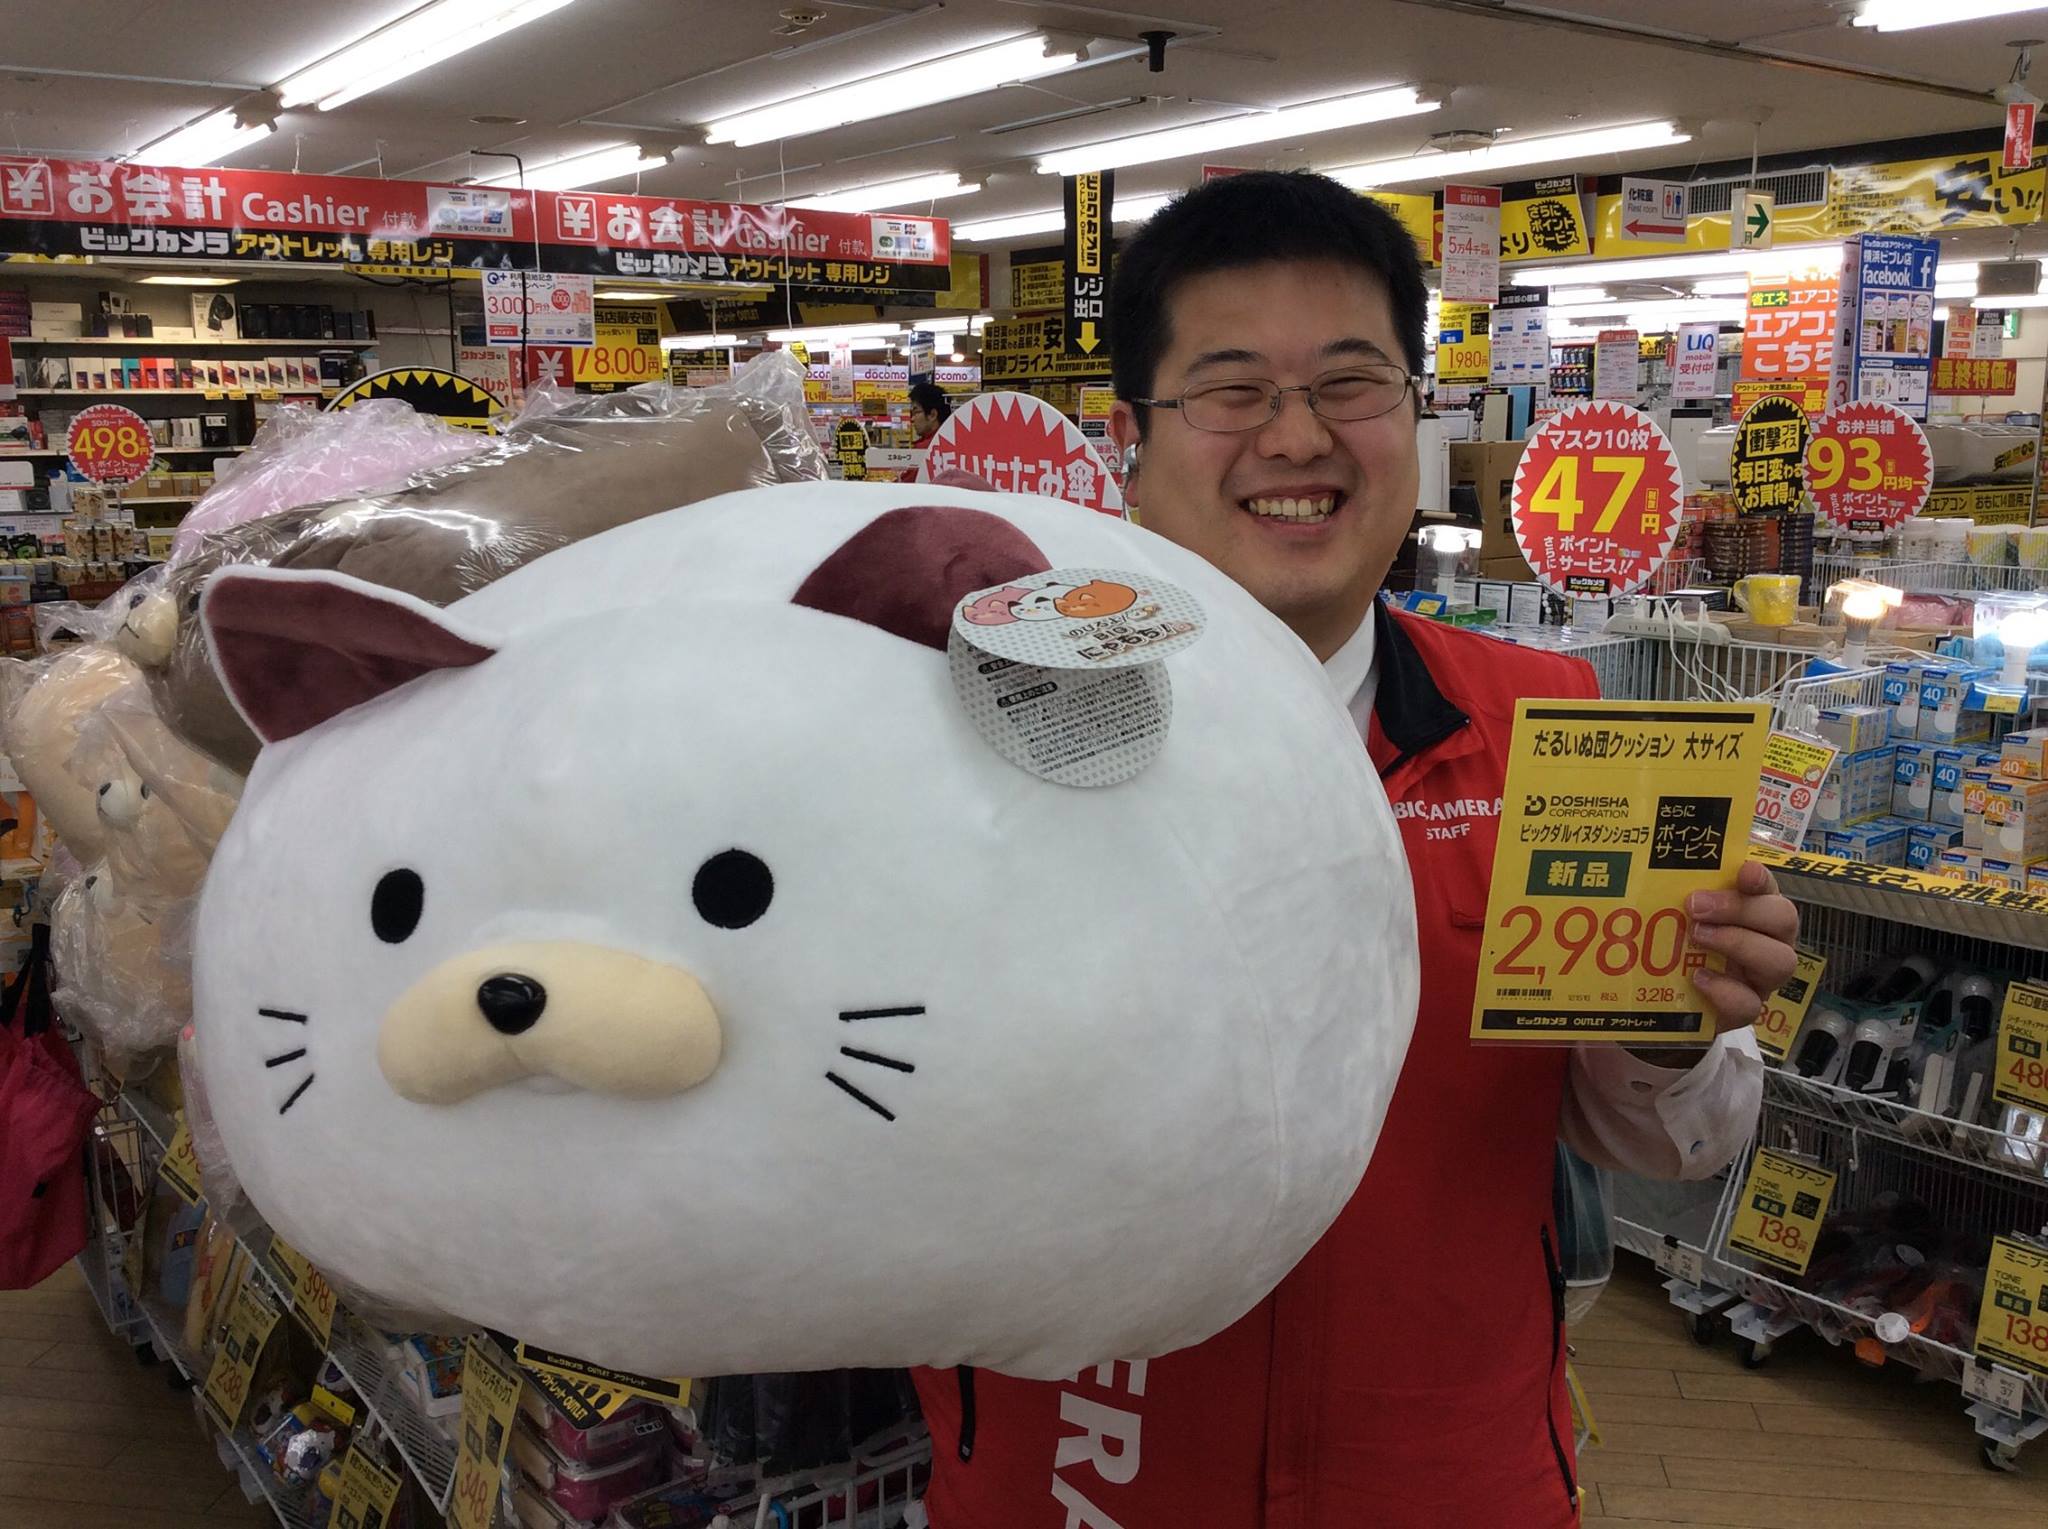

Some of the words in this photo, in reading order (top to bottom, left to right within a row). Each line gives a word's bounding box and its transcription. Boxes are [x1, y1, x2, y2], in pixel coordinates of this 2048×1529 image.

[67, 170, 227, 221] お会計
[242, 192, 370, 226] Cashier
[1528, 205, 1561, 219] さらに
[606, 203, 725, 247] お会計
[734, 223, 830, 254] Cashier
[1531, 218, 1577, 232] ポイント
[80, 226, 230, 255] ビックカメラ
[235, 233, 359, 258] アウトレット
[367, 238, 454, 263] 専用レジ
[1532, 232, 1579, 246] サービス
[1863, 249, 1913, 266] 横浜ビブレ店
[615, 251, 729, 277] ビックカメラ
[730, 257, 821, 282] アウトレット
[826, 262, 891, 284] 専用レジ
[1862, 263, 1911, 287] facebook
[1751, 291, 1789, 307] 省エネ
[1074, 298, 1104, 319] 出口
[1686, 332, 1715, 353] UQ
[984, 354, 1054, 376] 衝撃プライス
[1685, 353, 1712, 361] mobile
[864, 368, 907, 380] docomo
[1936, 359, 2017, 390] 最終特価!!
[1837, 419, 1896, 435] お弁当箱
[74, 426, 140, 460] 498
[1547, 428, 1651, 451] マスク10枚
[1749, 427, 1781, 453] 衝撃
[97, 460, 129, 468] ポイント
[1738, 458, 1802, 485] 毎日変わる
[1807, 436, 1884, 491] 93
[1883, 476, 1929, 491] 円均一
[1529, 455, 1646, 534] 47
[1744, 483, 1797, 509] お買得!!
[1842, 493, 1888, 505] ポイント
[1842, 505, 1901, 519] サービス!!
[1640, 512, 1661, 535] 円
[1543, 535, 1558, 570] さらに
[1559, 535, 1618, 555] ポイント
[1559, 555, 1635, 575] サービス!!
[1093, 625, 1130, 641] BIG
[1885, 682, 1904, 697] 40
[1923, 687, 1941, 701] 40
[1532, 729, 1676, 759] だるいぬ団クッション
[1682, 731, 1744, 761] 大サイズ
[1896, 762, 1915, 777] 40
[1937, 769, 1956, 783] 40
[2001, 760, 2020, 774] 40
[1550, 794, 1630, 809] DOSHISHA
[1986, 801, 2006, 816] 40
[1549, 807, 1629, 819] CORPORATION
[1660, 804, 1697, 818] さらに
[1426, 822, 1471, 841] STAFF
[1520, 823, 1651, 845] ビックダルイヌダンショコラ
[1656, 824, 1722, 843] ポイント
[1655, 842, 1719, 860] サービス
[1909, 844, 1929, 860] 40
[1546, 860, 1611, 889] 新品
[1516, 1016, 1568, 1027] ビックカメラ
[1573, 1017, 1606, 1027] OUTLET
[1610, 1017, 1657, 1028] アウトレット
[1760, 1156, 1827, 1187] ミニスプーン
[1994, 1269, 2022, 1285] TONE
[587, 1366, 610, 1378] OUTLET
[563, 1394, 589, 1422] OUTLET
